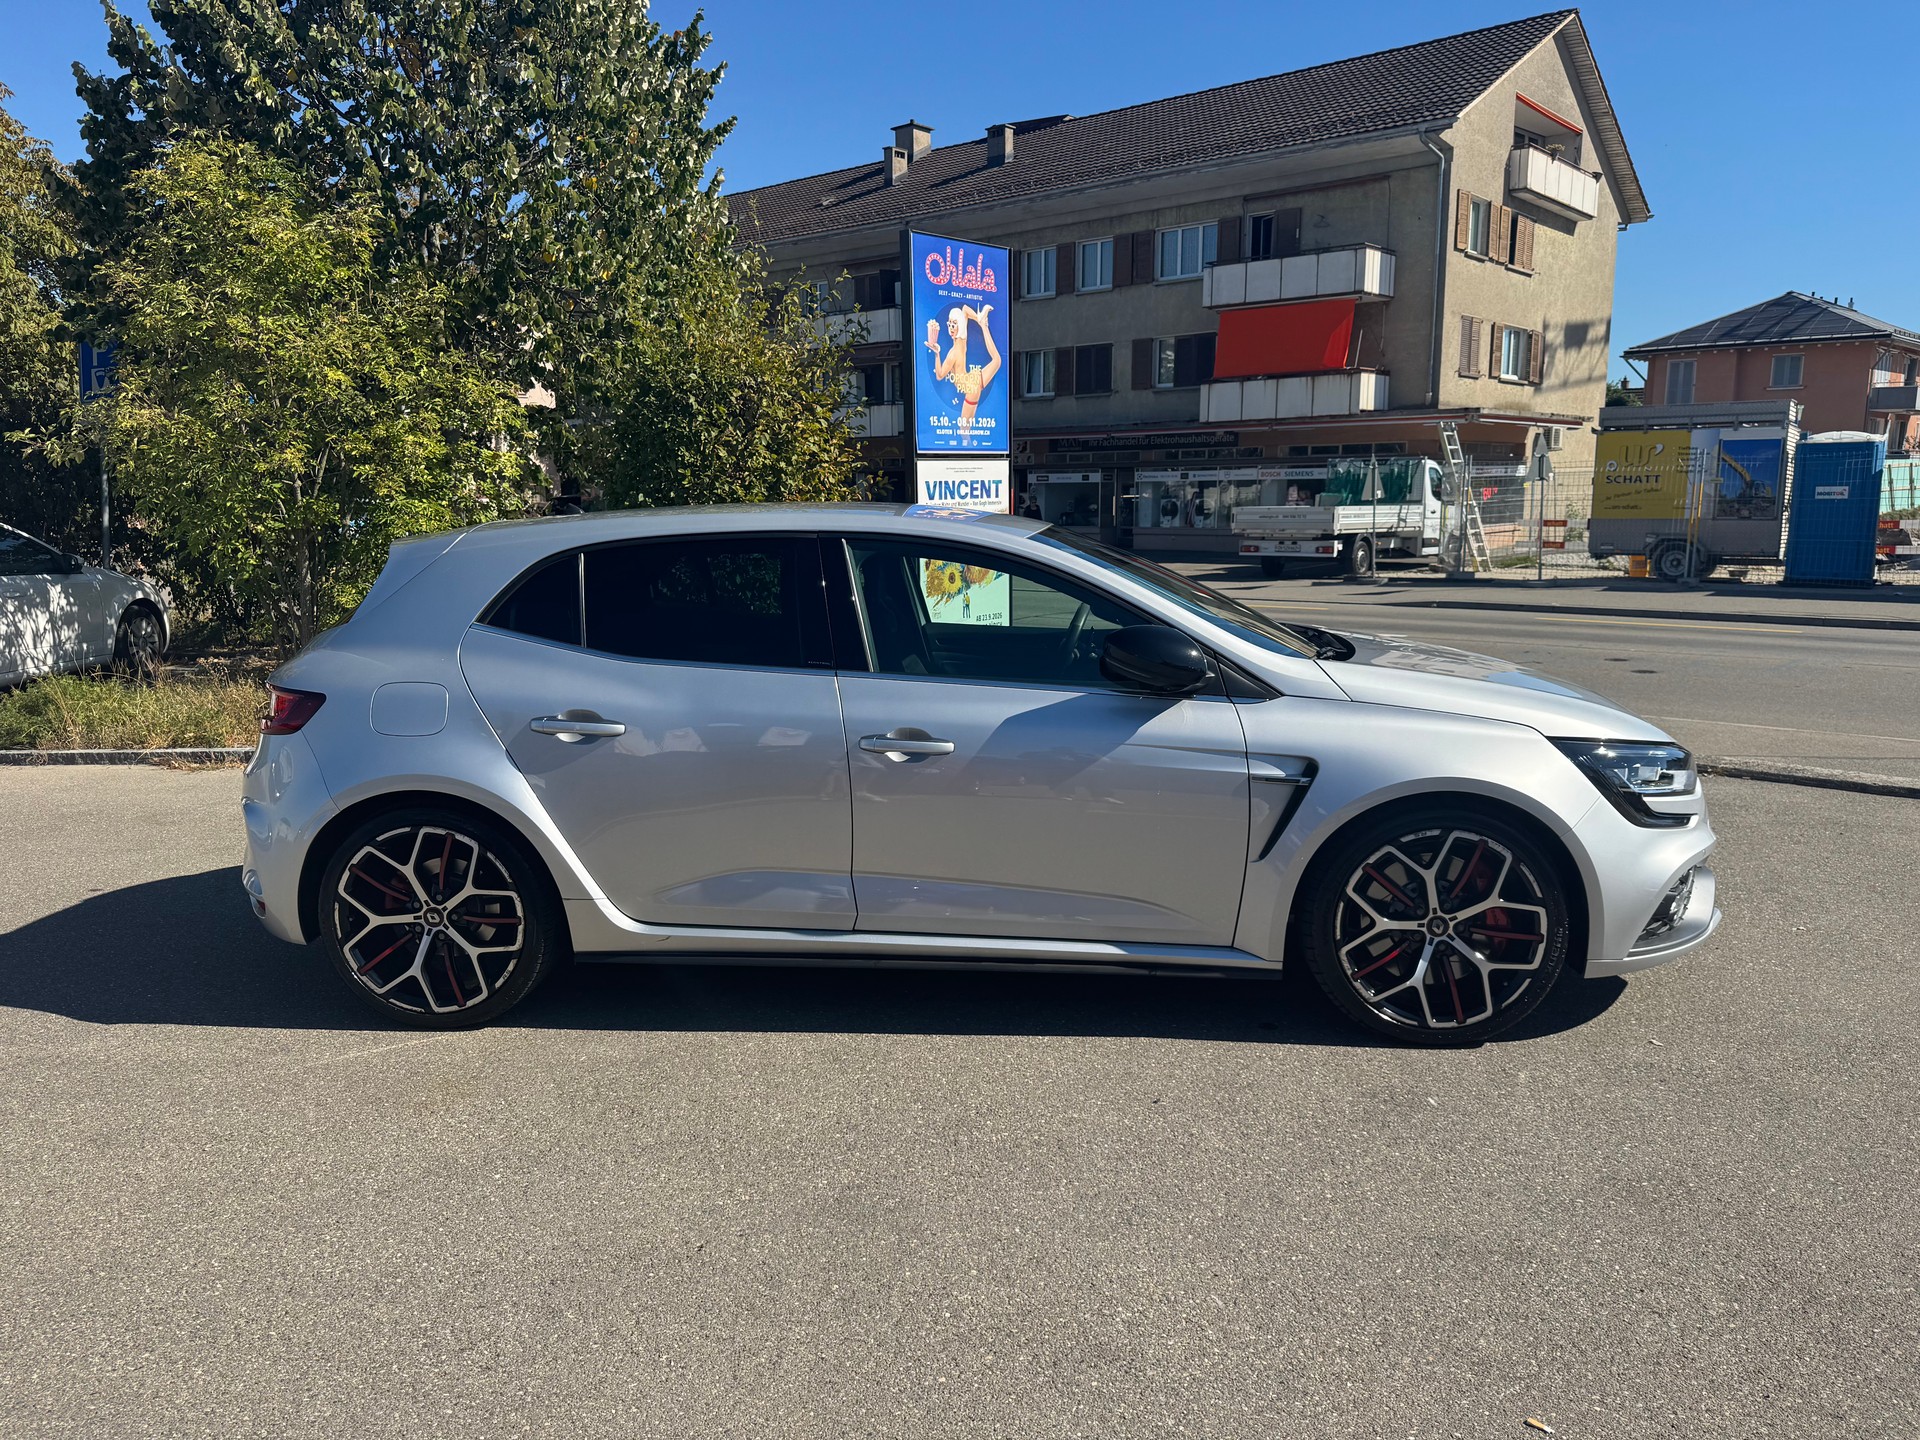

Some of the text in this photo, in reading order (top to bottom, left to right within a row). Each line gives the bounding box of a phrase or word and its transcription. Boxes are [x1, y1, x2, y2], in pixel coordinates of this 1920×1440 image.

[925, 245, 997, 293] Ohlala
[966, 293, 983, 301] ARTISTIC
[969, 365, 981, 374] THE
[945, 373, 980, 384] POPCORN
[957, 383, 979, 394] PARTY
[929, 416, 952, 426] 15.10.
[957, 416, 996, 428] 08.11.2026
[1099, 437, 1138, 447] Fachhandel
[1150, 434, 1234, 445] Elektrohaushaltsgeräte
[1284, 470, 1314, 478] SIEMENS
[1605, 474, 1661, 484] SCHATT
[925, 480, 1002, 500] VINCENT
